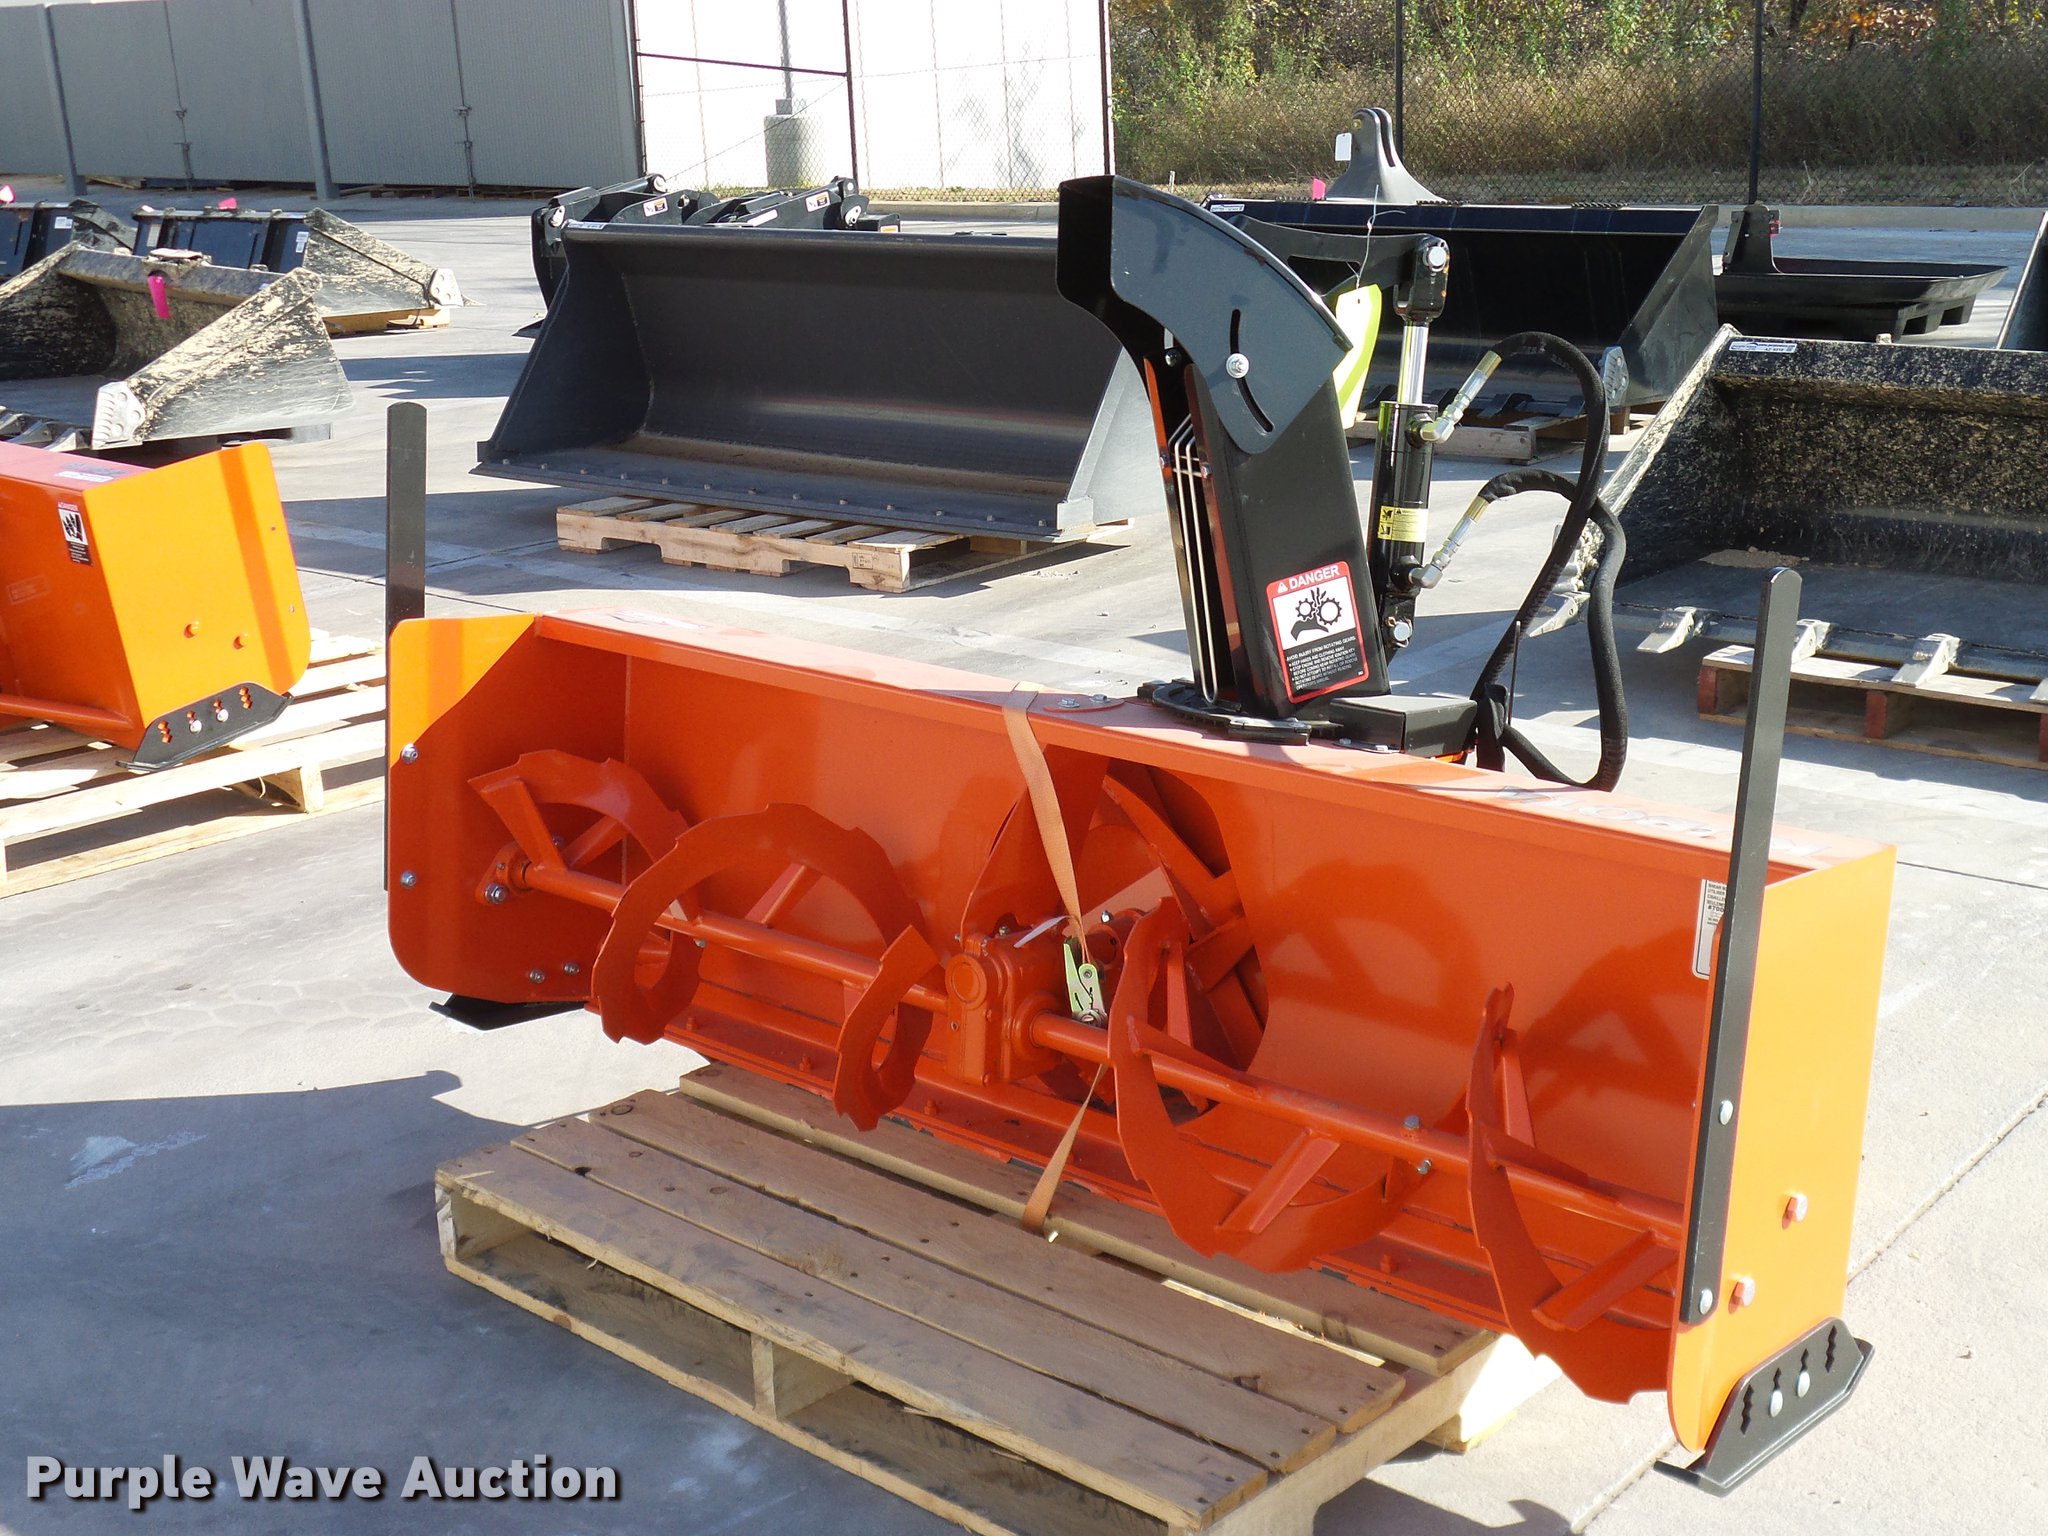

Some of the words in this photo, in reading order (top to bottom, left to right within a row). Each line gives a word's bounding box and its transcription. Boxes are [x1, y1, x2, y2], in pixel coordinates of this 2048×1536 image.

[1288, 565, 1340, 589] DANGER
[1286, 653, 1298, 661] AVOID
[1298, 649, 1311, 657] INJURY
[1323, 640, 1342, 650] ROTATING
[1321, 654, 1334, 662] REMOVE
[1293, 668, 1306, 676] BEFORE
[1329, 656, 1344, 665] ROTATING
[1307, 668, 1321, 676] ATTEMPT
[1295, 676, 1311, 685] ROTATING
